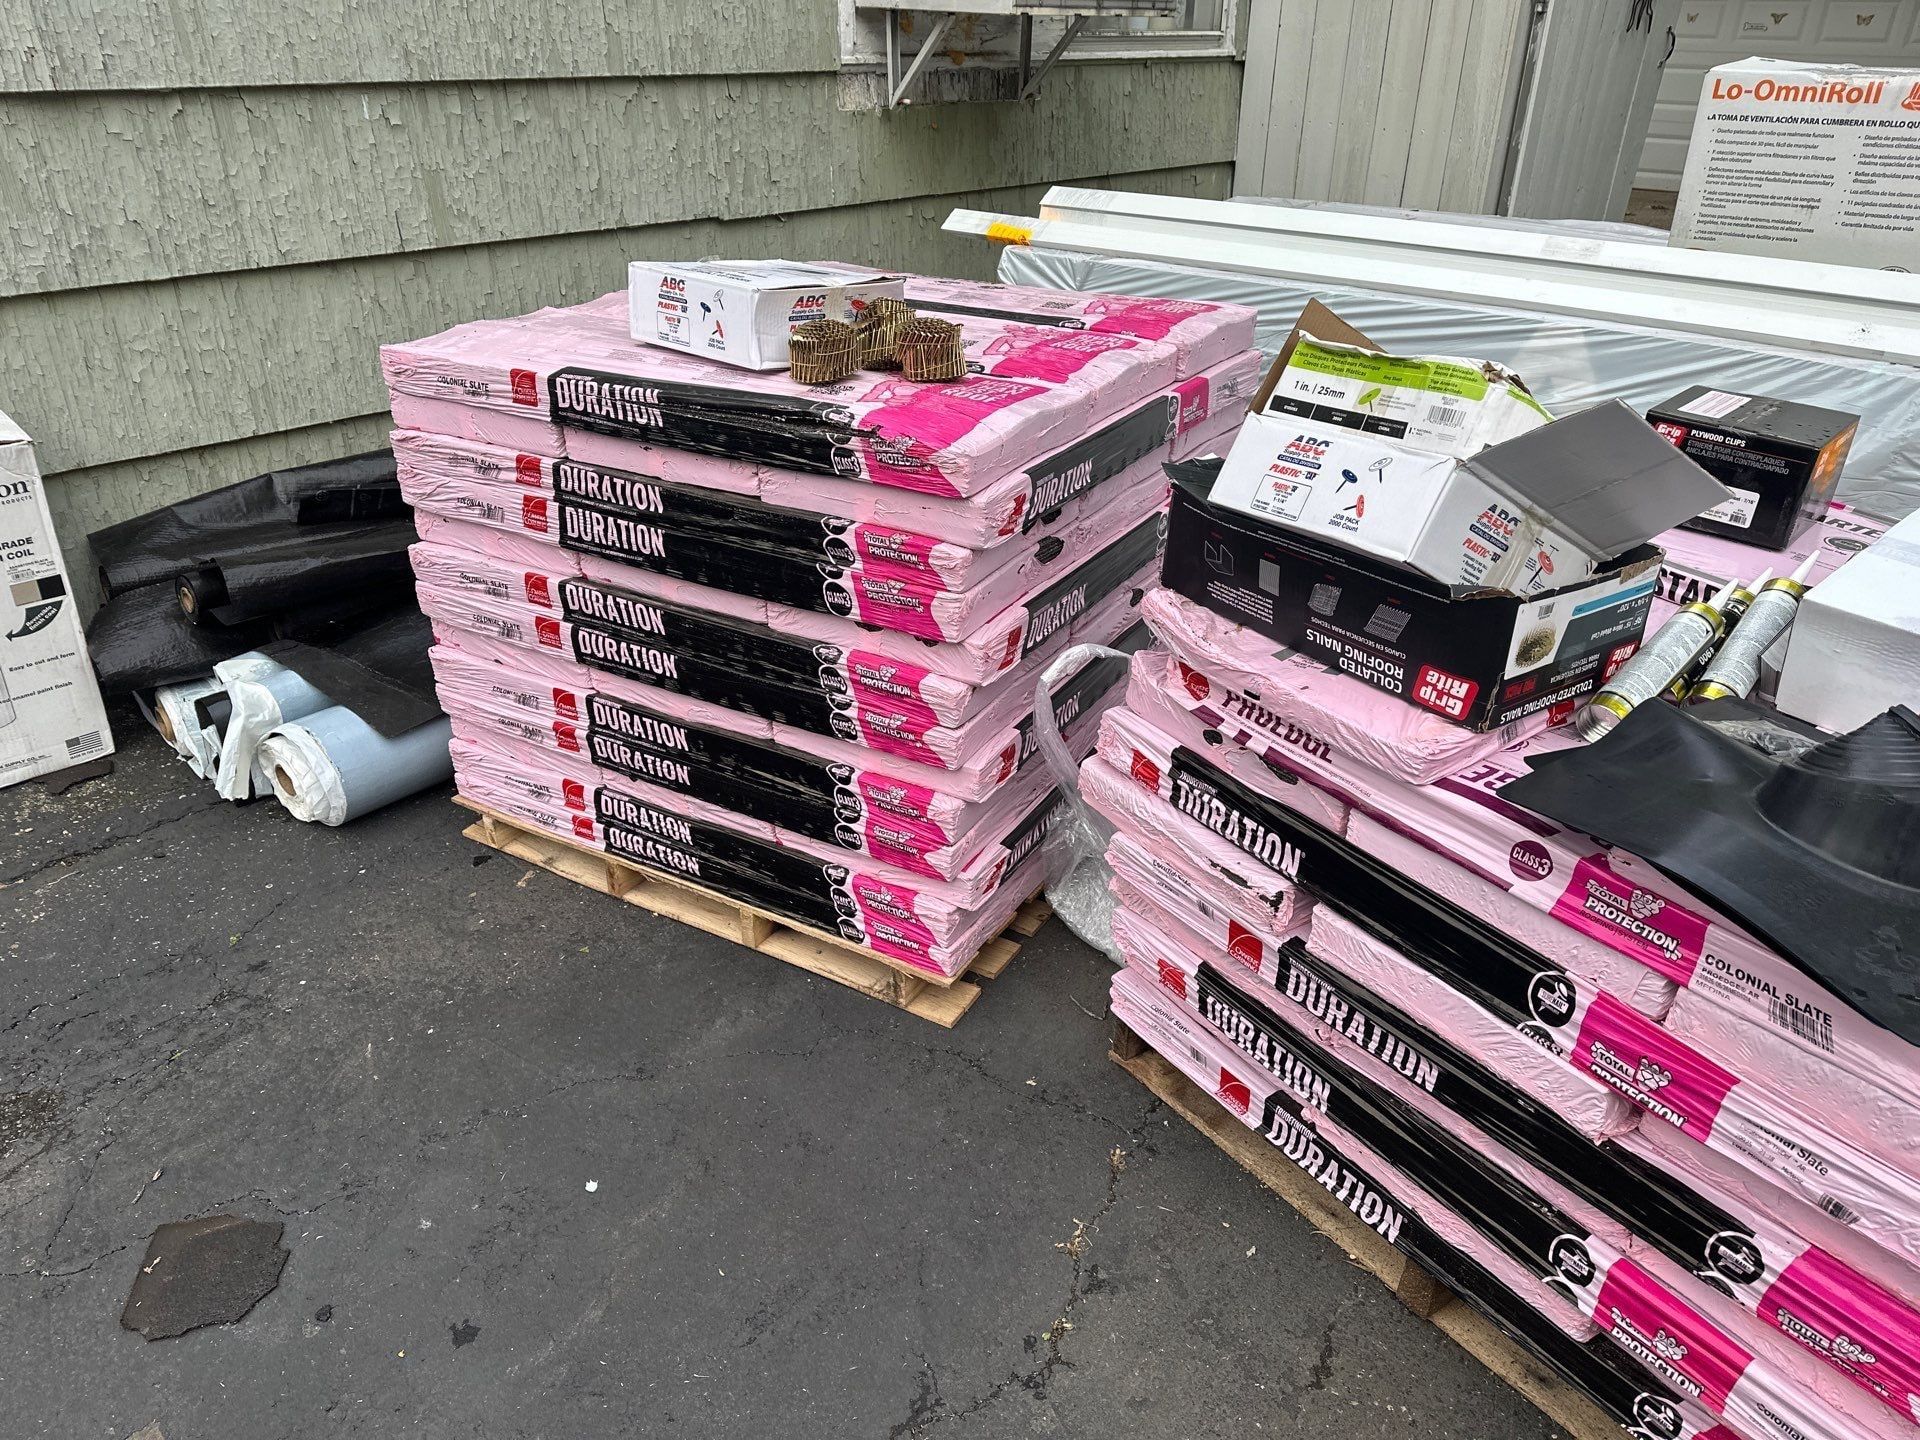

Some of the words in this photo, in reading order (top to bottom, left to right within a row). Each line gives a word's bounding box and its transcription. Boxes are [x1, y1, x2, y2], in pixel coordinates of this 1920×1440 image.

[1712, 79, 1886, 104] Lo-OmniRoll
[1750, 115, 1799, 124] VENTILACIÓN
[1800, 117, 1820, 125] PARA
[1822, 118, 1864, 127] CUMBRERA
[1879, 120, 1905, 128] ROLLO
[660, 276, 686, 292] ABC
[658, 301, 678, 312] PLASTIC
[792, 295, 827, 309] ABC
[1303, 359, 1319, 367] Clavos
[1358, 362, 1381, 371] Plastique
[437, 375, 469, 390] COLONIAL
[469, 379, 490, 392] SLATE
[1300, 382, 1310, 392] in.
[1317, 385, 1345, 399] 25mm
[555, 377, 663, 428] DURATION
[1657, 423, 1681, 438] Grip
[1691, 429, 1724, 443] PLYWOOD
[1725, 435, 1747, 448] CLIPS
[874, 440, 896, 450] TOTAL
[1283, 448, 1302, 458] Supply
[1284, 434, 1333, 456] ABC
[1713, 444, 1730, 455] POUR
[835, 456, 852, 470] CLASS
[1279, 454, 1299, 465] CATALOG
[1299, 459, 1320, 468] DIVISION
[1686, 447, 1716, 460] ANCLAJES
[1717, 454, 1734, 463] PARA
[1734, 457, 1789, 475] CONTRACHAPADO
[1269, 463, 1301, 478] PLASTIC
[559, 464, 662, 514] DURATION
[1029, 460, 1092, 520] DURATION
[1328, 519, 1341, 527] 2000
[1341, 522, 1358, 532] Count
[1332, 512, 1345, 521] JOB
[1344, 515, 1360, 525] PACK
[1475, 518, 1496, 532] Supply
[1478, 503, 1521, 537] ABC
[565, 506, 666, 558] DURATION
[867, 535, 889, 545] TOTAL
[1471, 525, 1492, 542] CATALOG
[1490, 537, 1508, 551] DIVISION
[6, 549, 34, 560] COIL
[868, 545, 919, 565] PROTECTION
[1462, 537, 1489, 558] PLASTIC
[1465, 559, 1478, 571] Roofing
[866, 581, 887, 591] TOTAL
[826, 591, 844, 604] CLASS
[867, 591, 919, 607] PROTECTION
[26, 606, 52, 627] Reversible
[565, 583, 666, 636] DURATION
[1026, 584, 1086, 649] DURATION
[29, 618, 46, 630] finish
[473, 614, 501, 625] COLONIAL
[502, 622, 521, 631] SLATE
[1311, 617, 1330, 629] TECHOS
[1331, 625, 1345, 634] PARA
[1306, 628, 1341, 653] NAILS
[1346, 630, 1375, 647] SECUENCIA
[60, 651, 75, 659] form
[578, 629, 678, 679] DURATION
[1385, 646, 1406, 659] CLAVOS
[1588, 653, 1600, 661] PARA
[1612, 644, 1635, 660] Rite
[1345, 645, 1404, 680] ROOFING
[1571, 658, 1588, 668] TECHOS
[1582, 661, 1598, 671] CLAVOS
[822, 674, 840, 689] CLASS
[859, 668, 879, 678] TOTAL
[1339, 657, 1402, 693] COLLATED
[1550, 670, 1575, 683] SECUENCIA
[12, 691, 36, 700] enamel
[37, 686, 54, 695] paint
[55, 681, 73, 690] finish
[860, 677, 912, 696] PROTECTION
[1425, 670, 1470, 694] Rite
[1558, 679, 1593, 701] COLLATED
[1419, 684, 1464, 717] Grip
[1522, 696, 1557, 714] ROOFING
[867, 714, 887, 725] TOTAL
[1500, 710, 1521, 724] NAILS
[592, 701, 689, 752] DURATION
[871, 724, 915, 741] PROTECTION
[1022, 692, 1081, 760] DUTION
[4, 759, 26, 768] SUPPLY
[594, 734, 691, 786] DURATION
[837, 794, 854, 808] CLASS
[538, 812, 558, 824] SLATE
[600, 794, 694, 846] DURATION
[838, 830, 854, 843] CLASS
[1176, 779, 1300, 878] DURATION
[609, 827, 701, 877] DURATION
[1512, 847, 1540, 870] CLASS
[1539, 859, 1550, 876] 3
[1594, 888, 1626, 908] TOTAL
[866, 900, 911, 919] PROTECTION
[1585, 896, 1678, 951] PROTECTION
[1704, 953, 1780, 1000] COLONIAL
[1784, 992, 1833, 1028] SLATE
[1748, 990, 1760, 1000] AR
[1173, 1020, 1190, 1035] Slate
[1285, 964, 1440, 1093] DURATION
[1205, 995, 1331, 1114] DURATION
[1599, 1052, 1633, 1077] TOTAL
[1275, 1105, 1316, 1140] TRUDEFINITION
[1797, 1148, 1829, 1176] Slate
[1264, 1115, 1403, 1244] DURATION
[1785, 1314, 1827, 1343] TOTAL
[1611, 1325, 1699, 1398] PROTECTION
